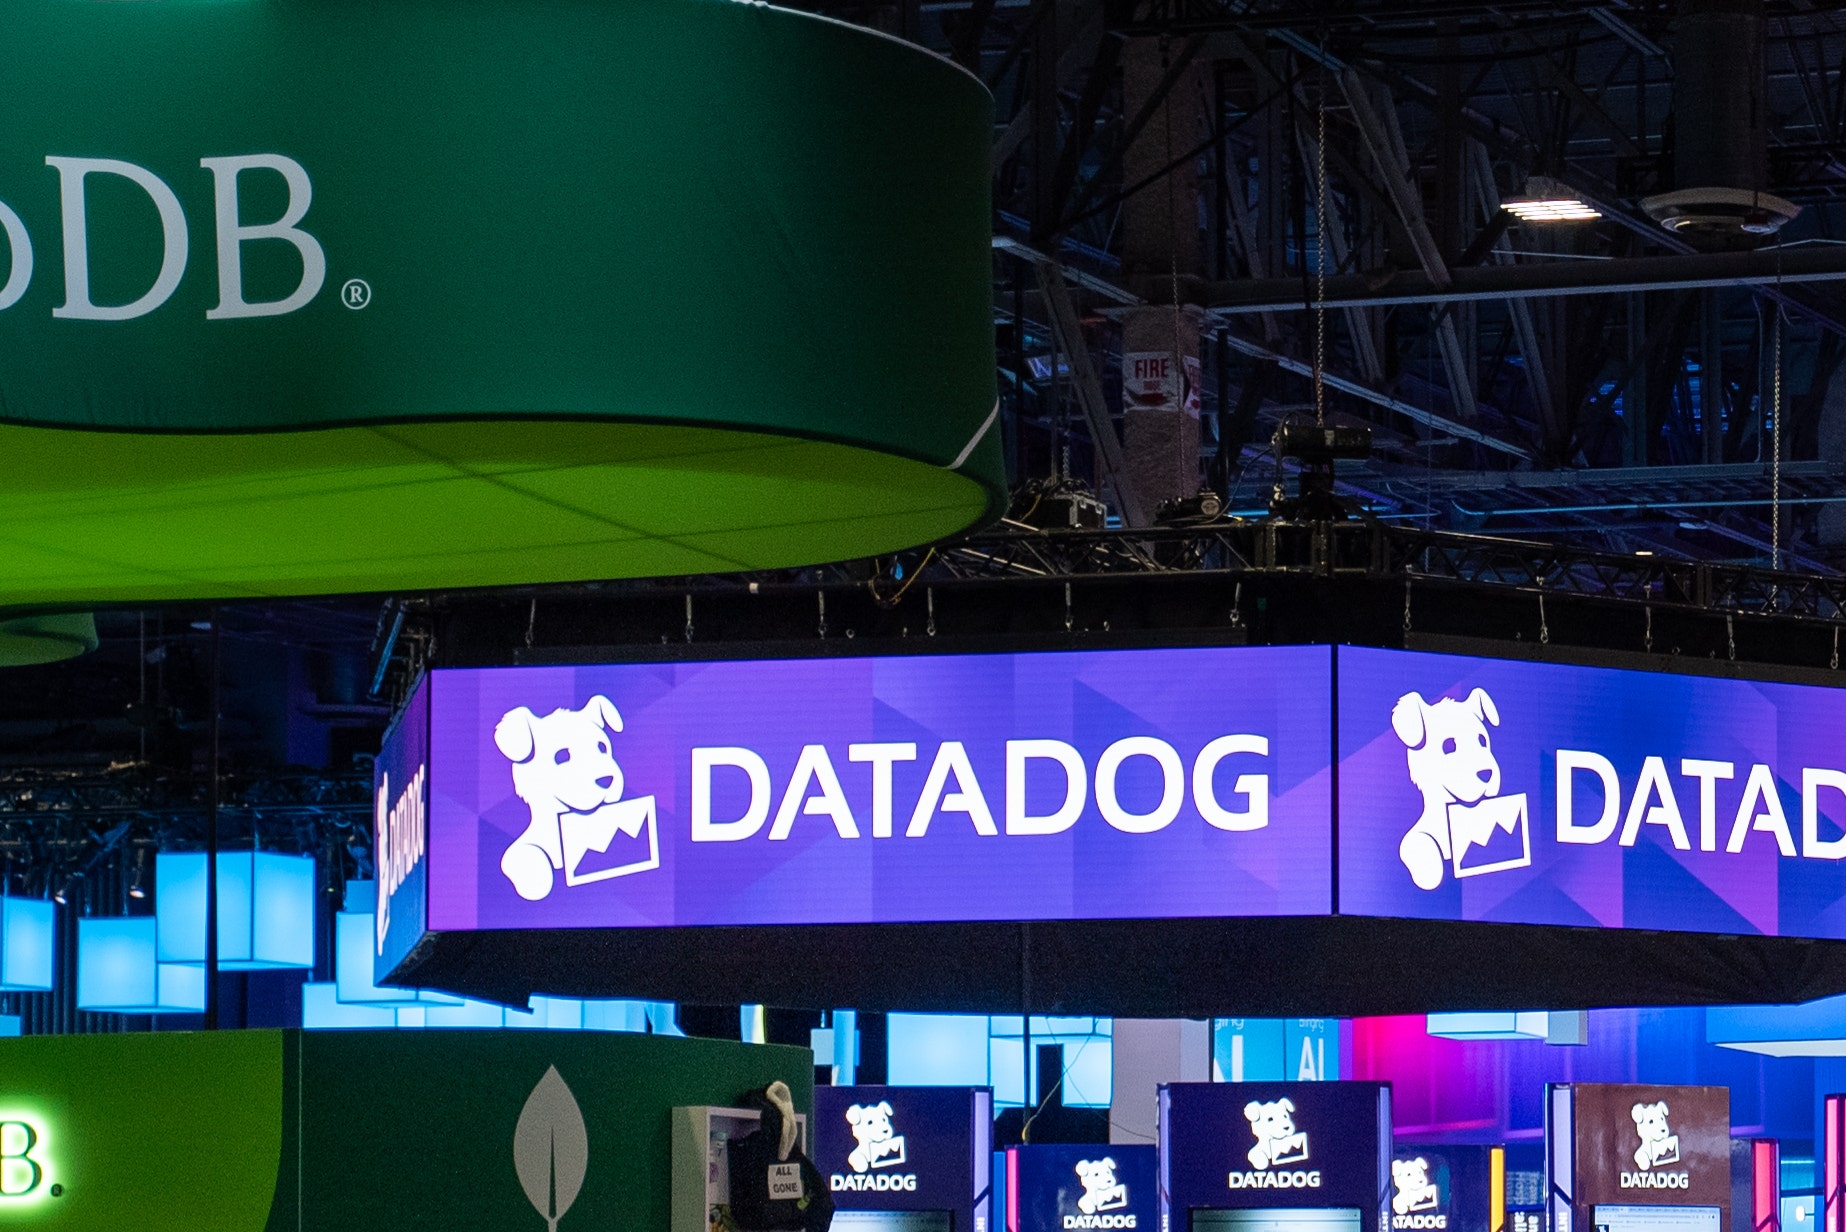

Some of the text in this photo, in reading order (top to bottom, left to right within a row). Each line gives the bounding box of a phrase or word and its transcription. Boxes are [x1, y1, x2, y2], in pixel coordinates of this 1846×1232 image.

[1135, 359, 1169, 379] FIRE
[692, 735, 1270, 842] DATADOG
[1298, 1036, 1324, 1082] AI
[775, 1166, 792, 1177] ALL
[1228, 1171, 1321, 1189] DATADOG
[772, 1183, 798, 1193] GONE
[830, 1174, 917, 1191] DATADOG
[1620, 1172, 1690, 1190] DATADOG
[1063, 1214, 1137, 1230] DATADOG
